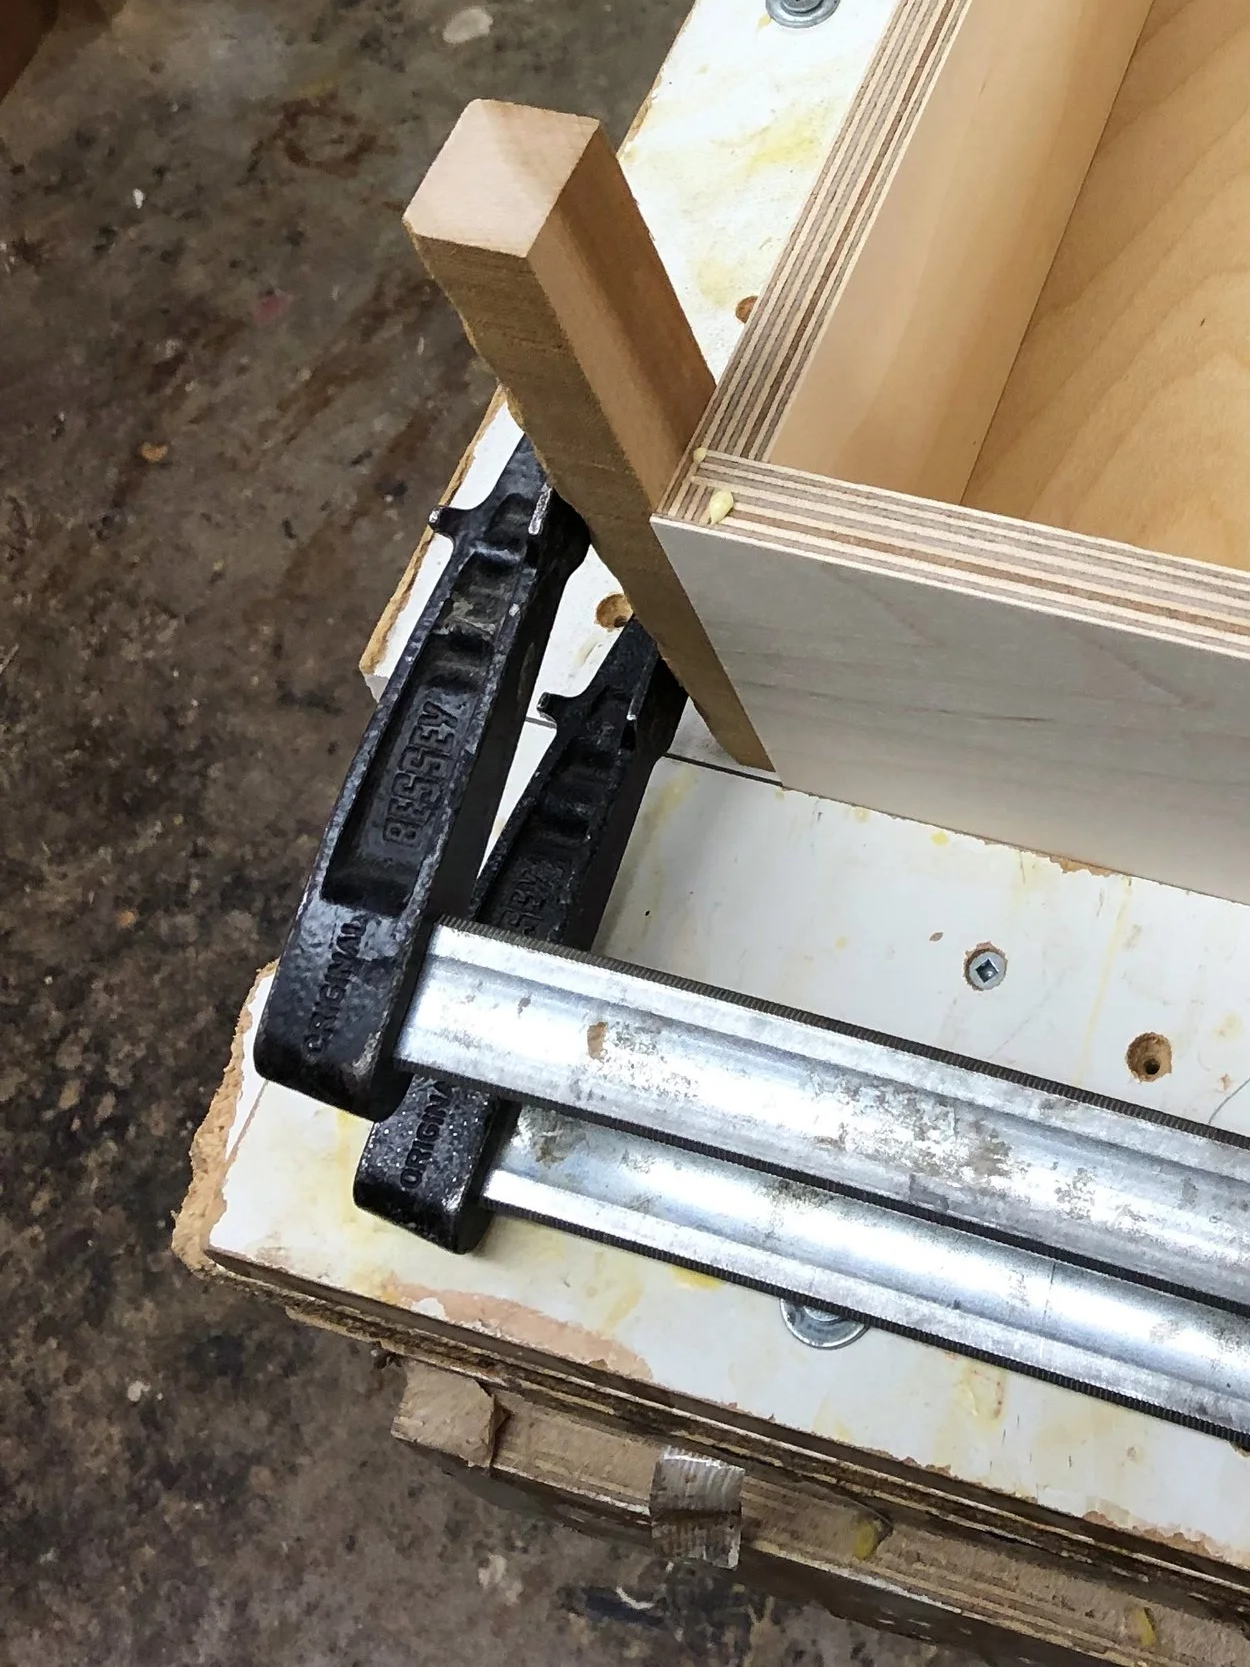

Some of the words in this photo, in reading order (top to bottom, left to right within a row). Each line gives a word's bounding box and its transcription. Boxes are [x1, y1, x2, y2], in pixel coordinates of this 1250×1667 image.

[383, 700, 459, 848] BESSEY
[304, 914, 370, 1053] ORIGINAL
[400, 1081, 448, 1189] ORIGINA
